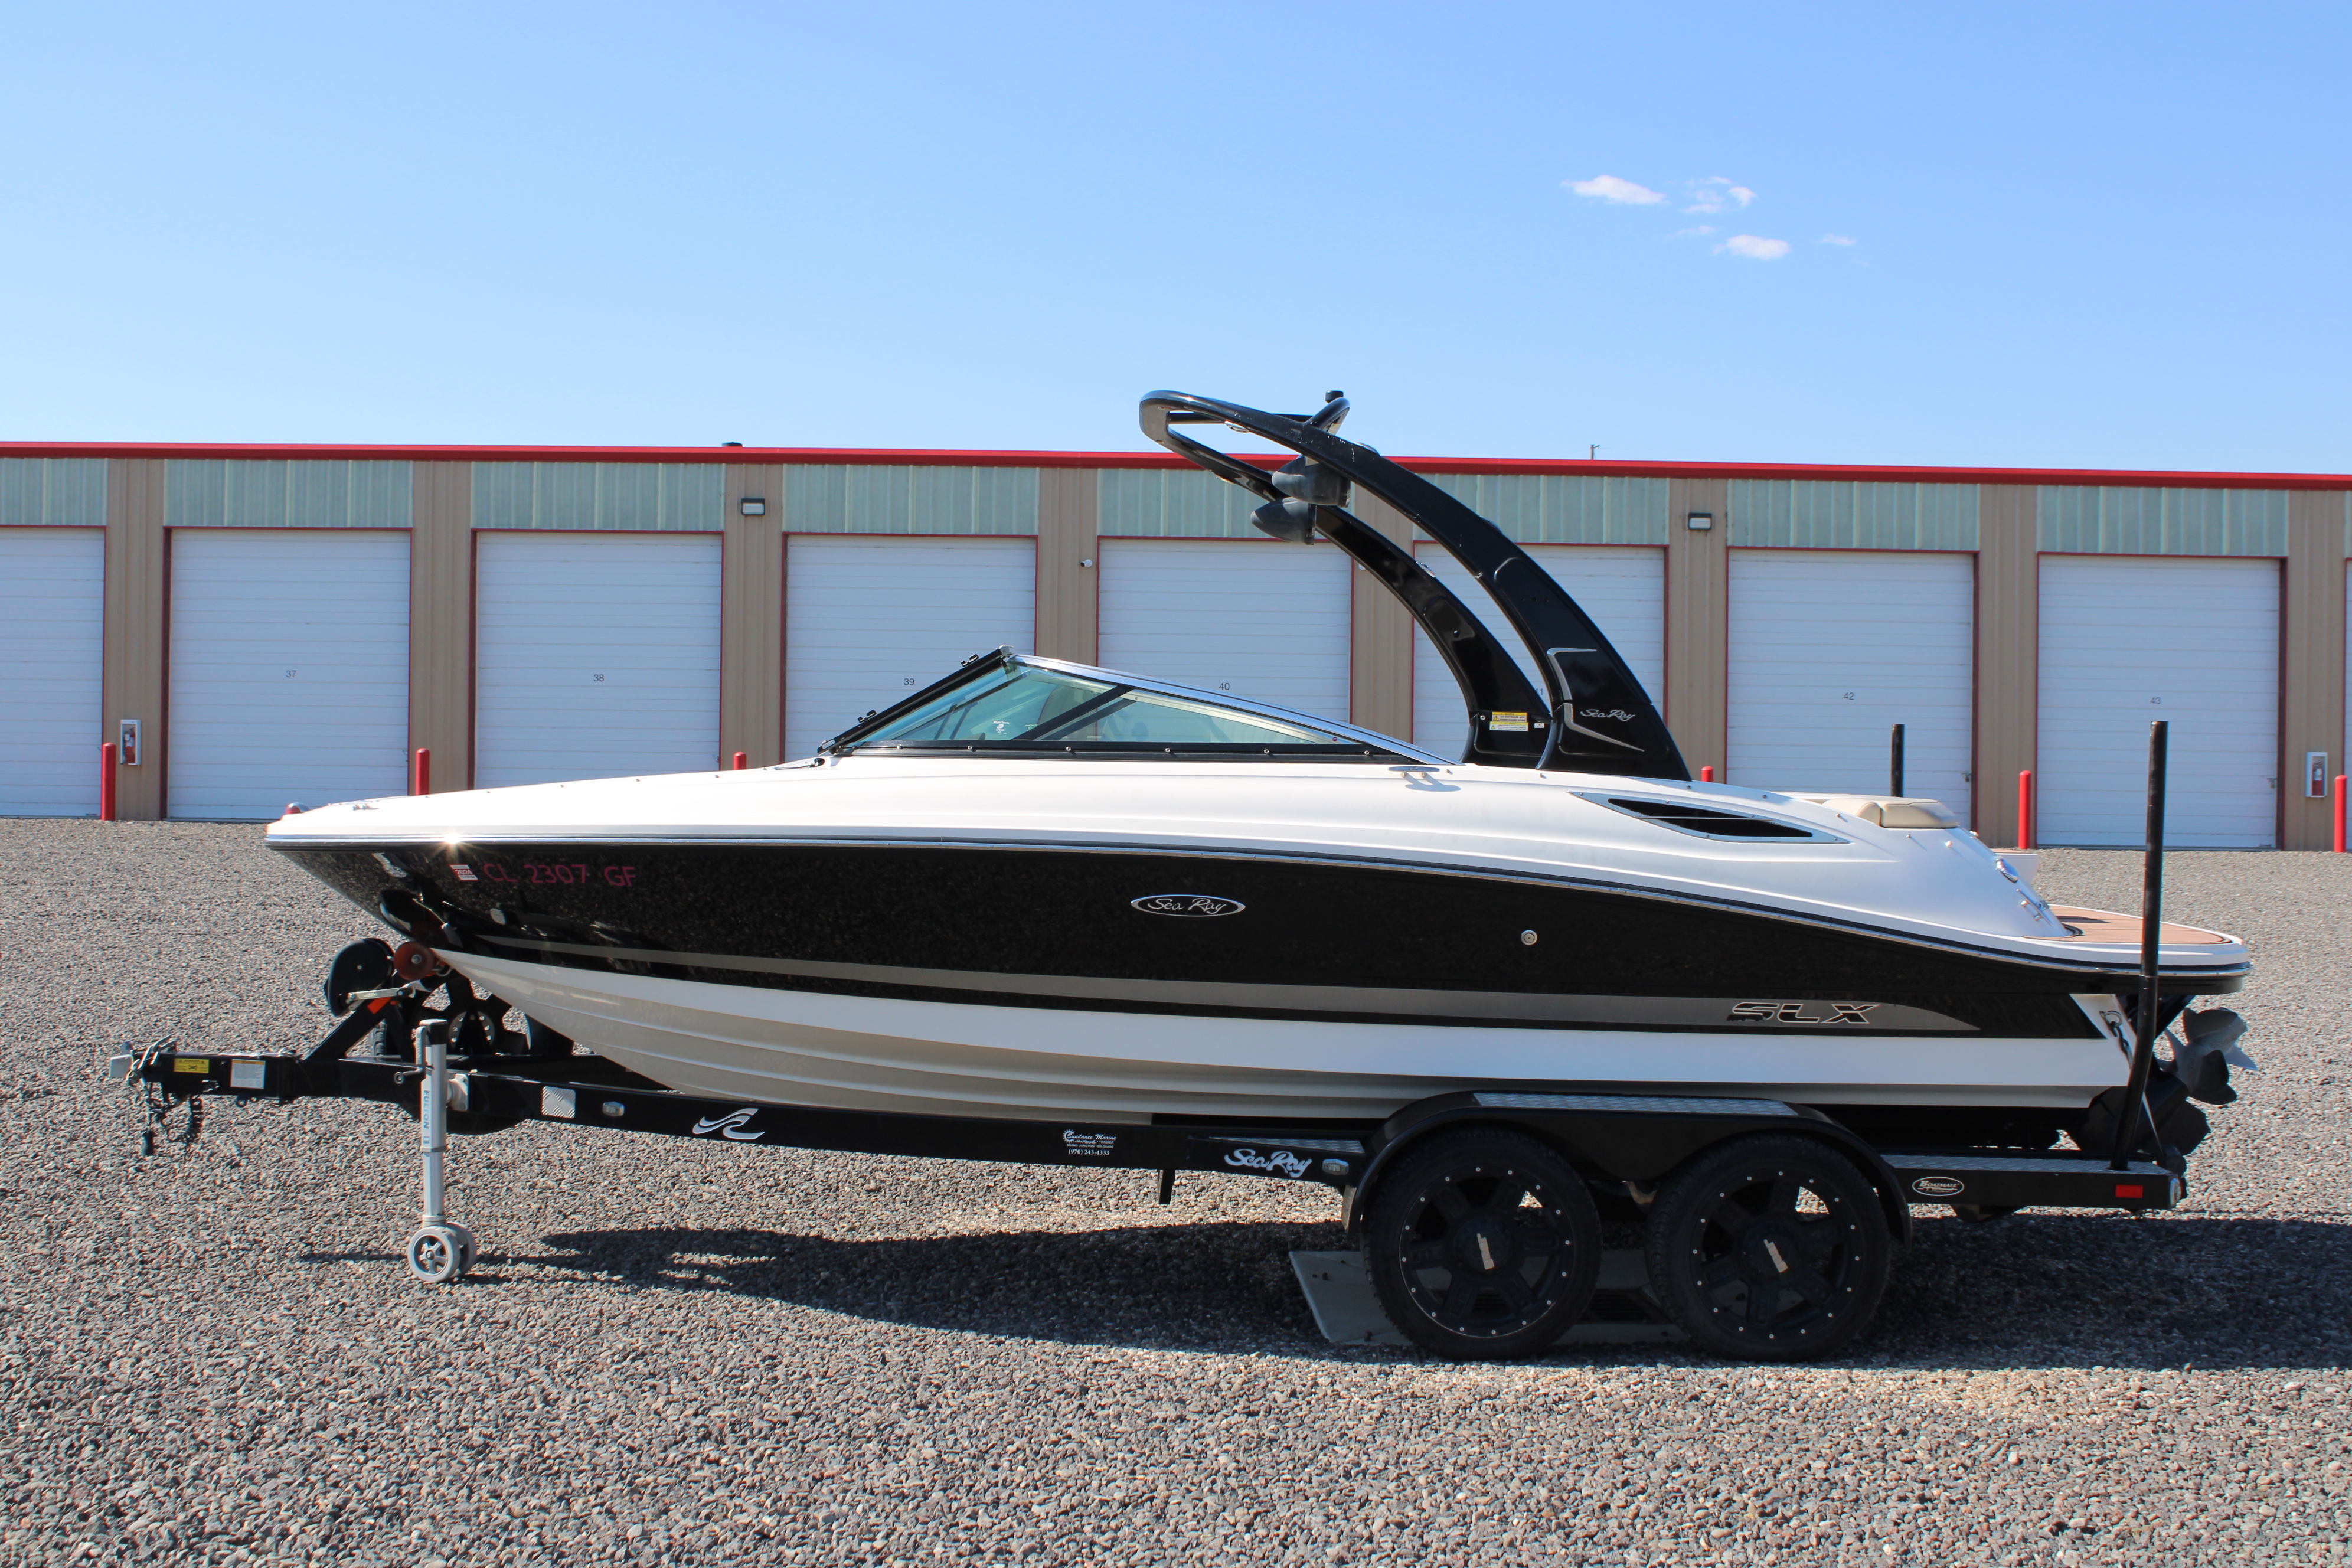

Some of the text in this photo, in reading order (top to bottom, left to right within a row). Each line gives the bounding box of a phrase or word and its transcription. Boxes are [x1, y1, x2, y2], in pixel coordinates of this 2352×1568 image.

[286, 669, 297, 678] 37
[593, 674, 605, 682] 38
[904, 678, 914, 686] 39
[1843, 692, 1855, 700] 42
[2150, 697, 2161, 705] 43
[483, 863, 636, 886] CL 2307 GF
[1147, 897, 1227, 914] Sea Ray
[1726, 1001, 1881, 1024] SLX
